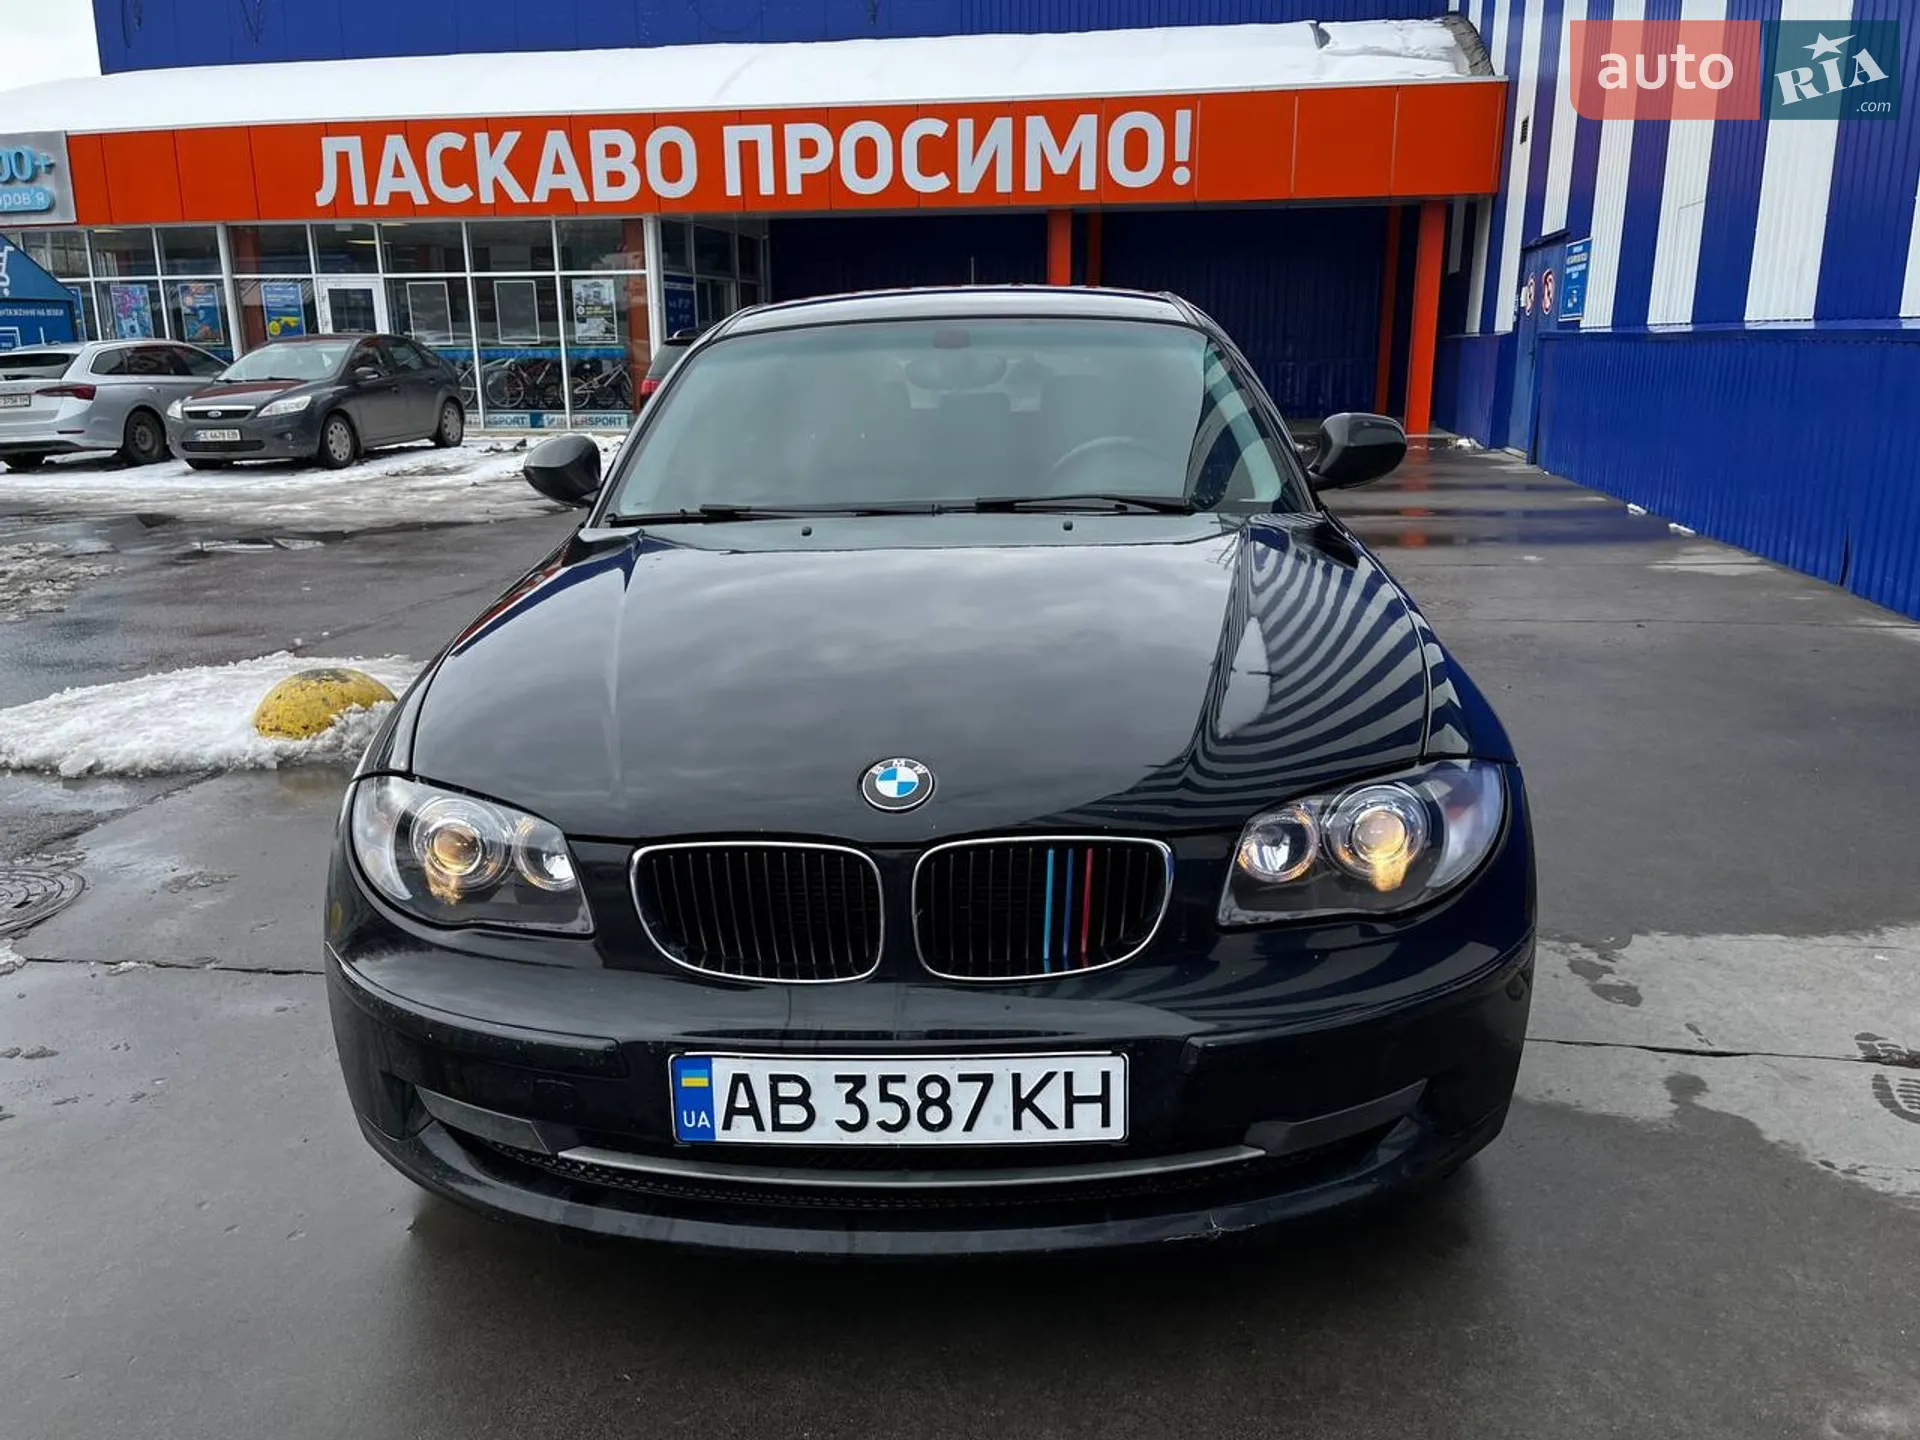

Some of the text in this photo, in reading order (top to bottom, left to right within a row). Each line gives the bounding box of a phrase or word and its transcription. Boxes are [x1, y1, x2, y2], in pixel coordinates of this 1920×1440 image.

[315, 108, 1192, 207] ЛАСКАВО ПРОСИМО!
[683, 1071, 1111, 1133] UA AB 3587 KH
